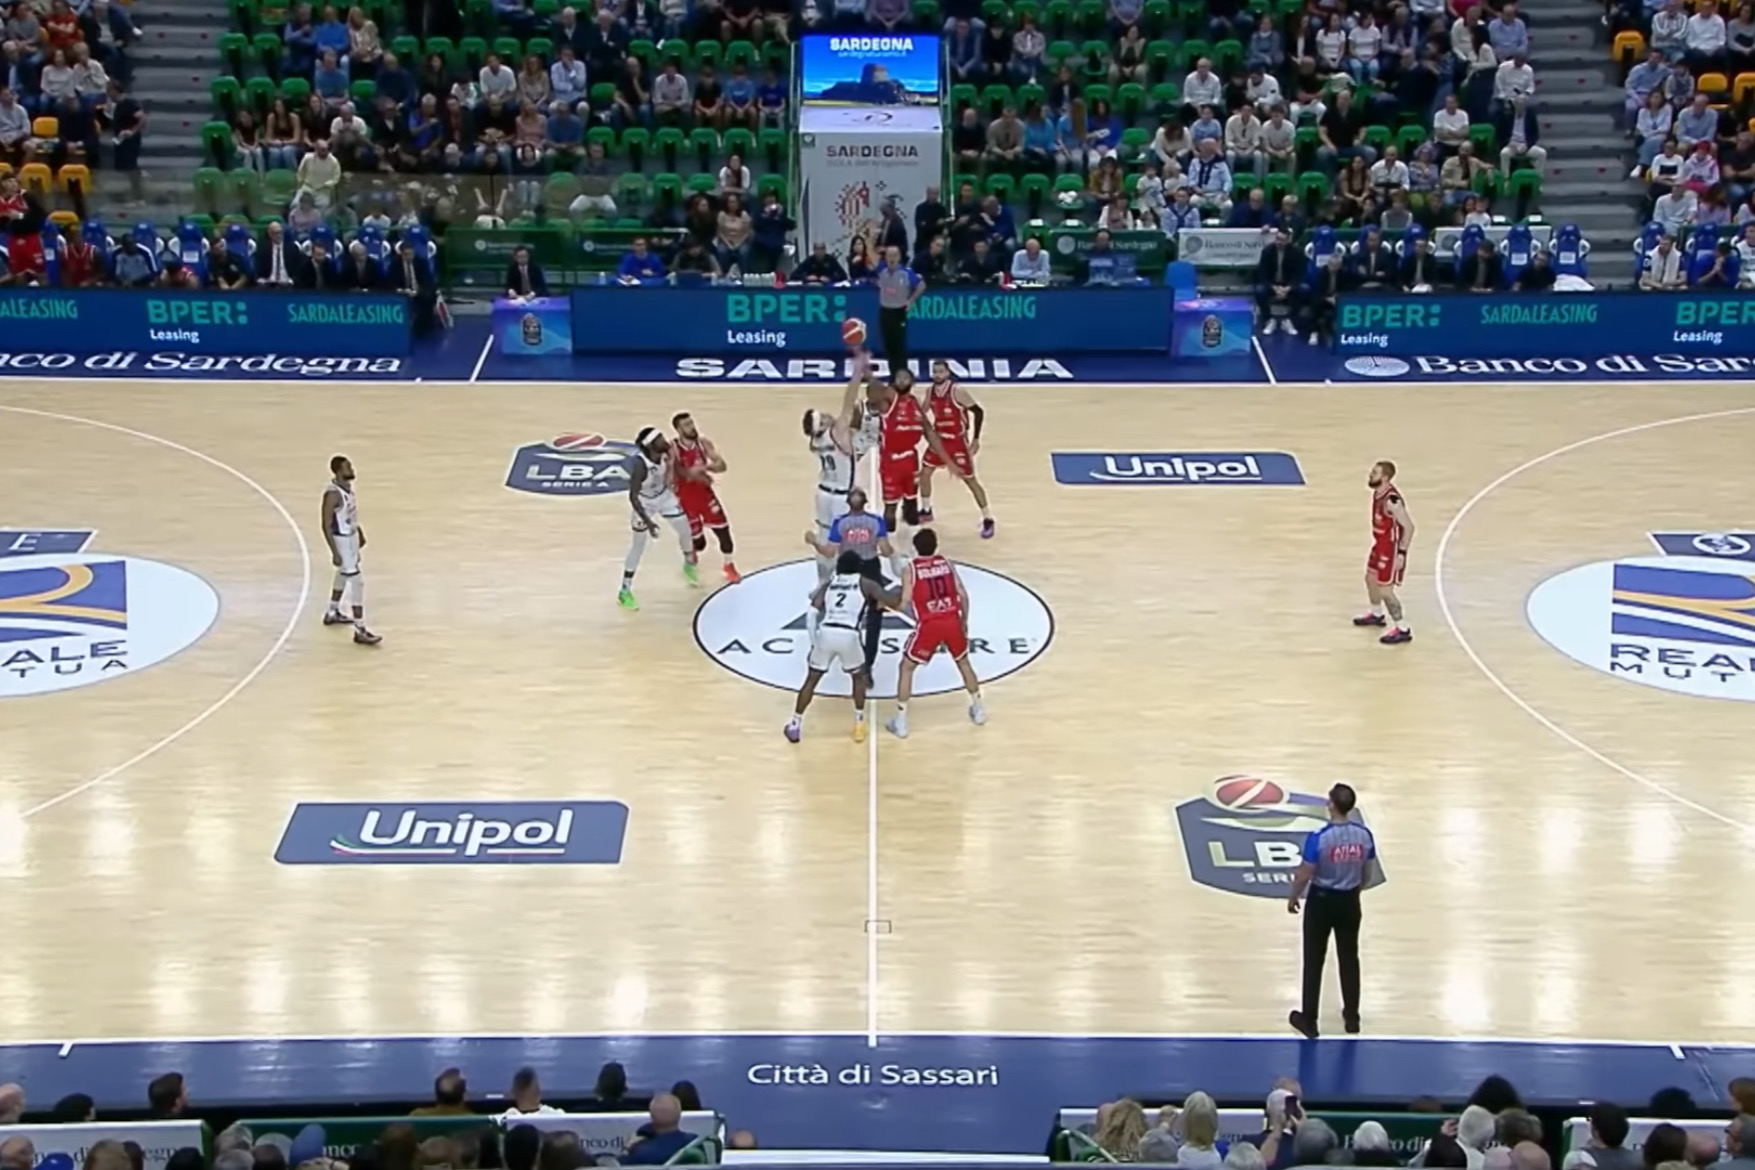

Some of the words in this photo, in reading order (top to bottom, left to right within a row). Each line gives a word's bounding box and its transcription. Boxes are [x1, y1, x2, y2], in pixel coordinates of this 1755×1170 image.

[829, 37, 914, 51] SARDEGNA
[826, 145, 919, 158] SARDEGNA
[287, 303, 404, 324] SARDALEASING
[906, 294, 1037, 319] ARDALEASING
[1481, 304, 1598, 324] SARDALEASING
[150, 328, 200, 343] Leasing
[727, 330, 787, 347] Leasing
[1340, 332, 1389, 347] Leasing
[1673, 330, 1723, 345] Leasing
[84, 352, 138, 369] di
[144, 352, 401, 376] Sardegna
[676, 358, 1074, 380] SARDINIA
[1414, 355, 1588, 374] Banco
[1596, 354, 1650, 373] di
[1653, 353, 1755, 373] Sar
[526, 464, 632, 480] LBA
[1104, 455, 1261, 482] Unipol
[833, 593, 847, 608] 2
[717, 637, 1029, 655] ACSRE
[358, 809, 574, 857] Unipol
[1207, 841, 1303, 868] LB
[1242, 872, 1295, 885] SERI
[747, 1063, 829, 1085] Città
[838, 1063, 870, 1085] di
[881, 1064, 998, 1086] Sassari
